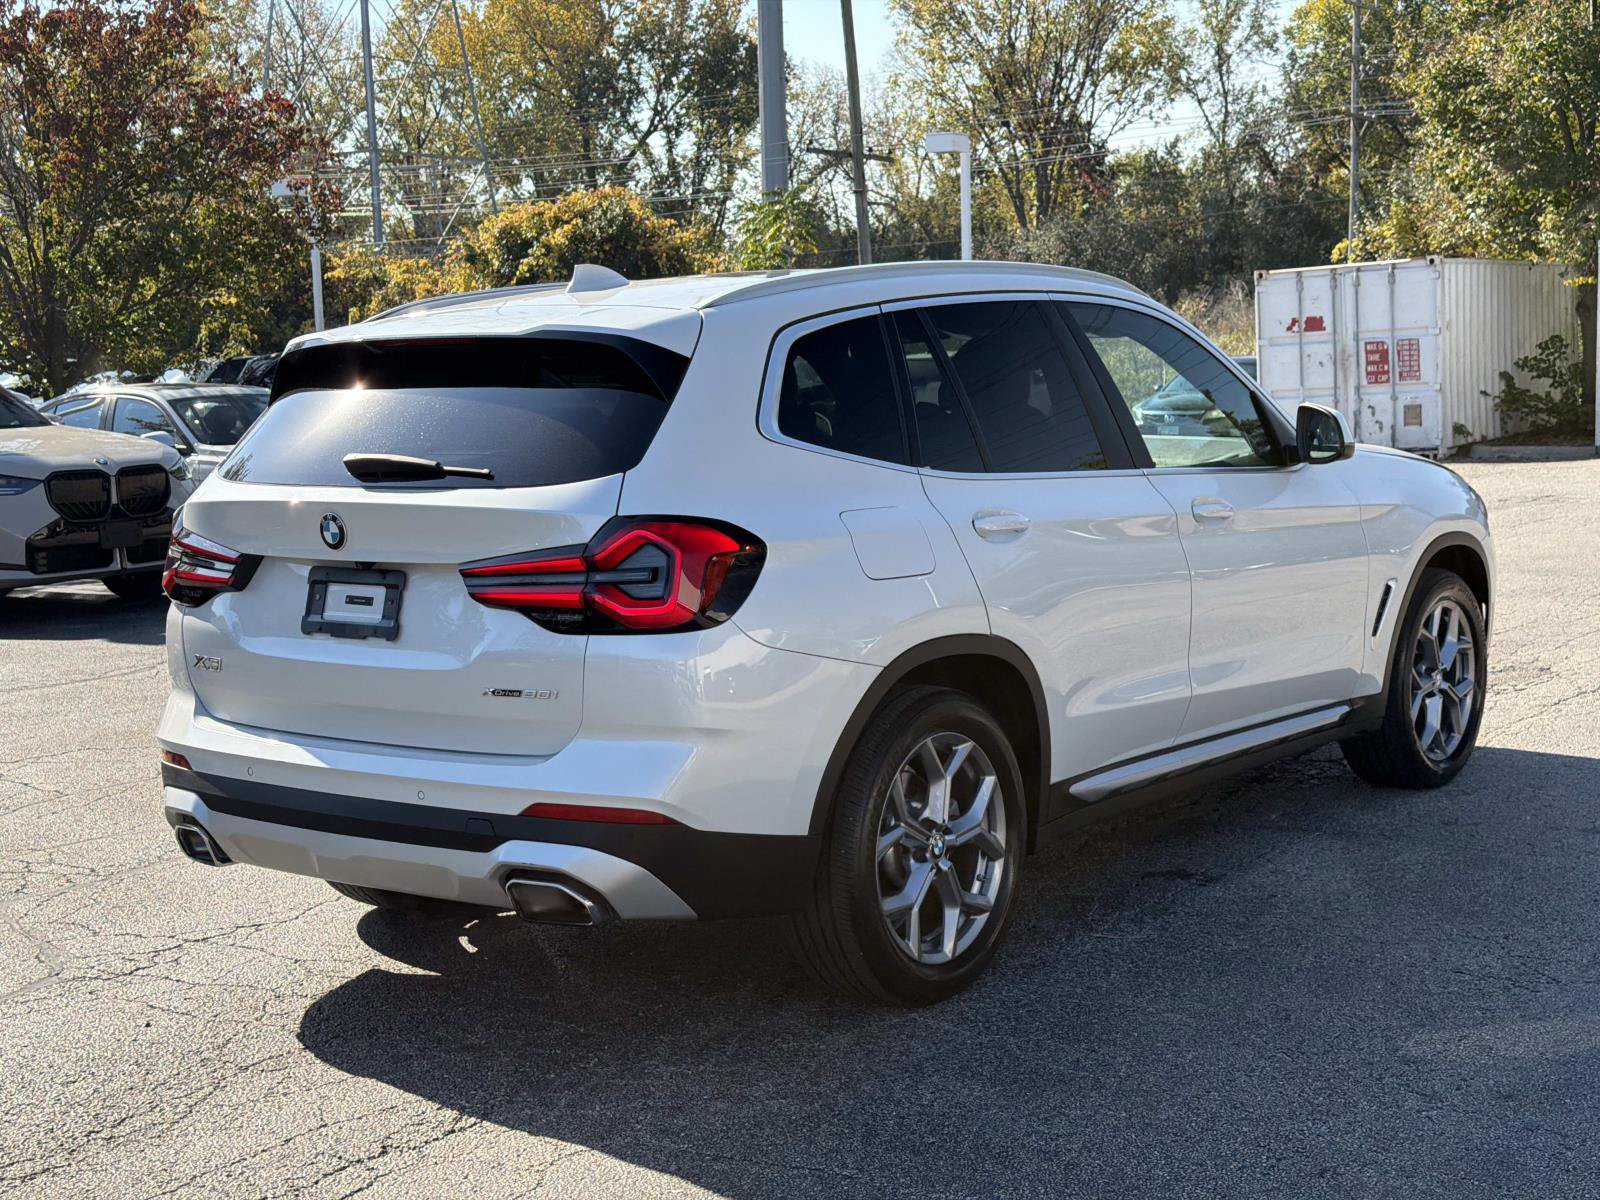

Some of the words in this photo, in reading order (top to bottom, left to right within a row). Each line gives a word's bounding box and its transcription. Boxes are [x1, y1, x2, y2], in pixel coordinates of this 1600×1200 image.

[1366, 343, 1377, 351] MAX
[1367, 353, 1380, 362] TARE
[1366, 364, 1377, 372] MAX
[194, 653, 222, 672] X3
